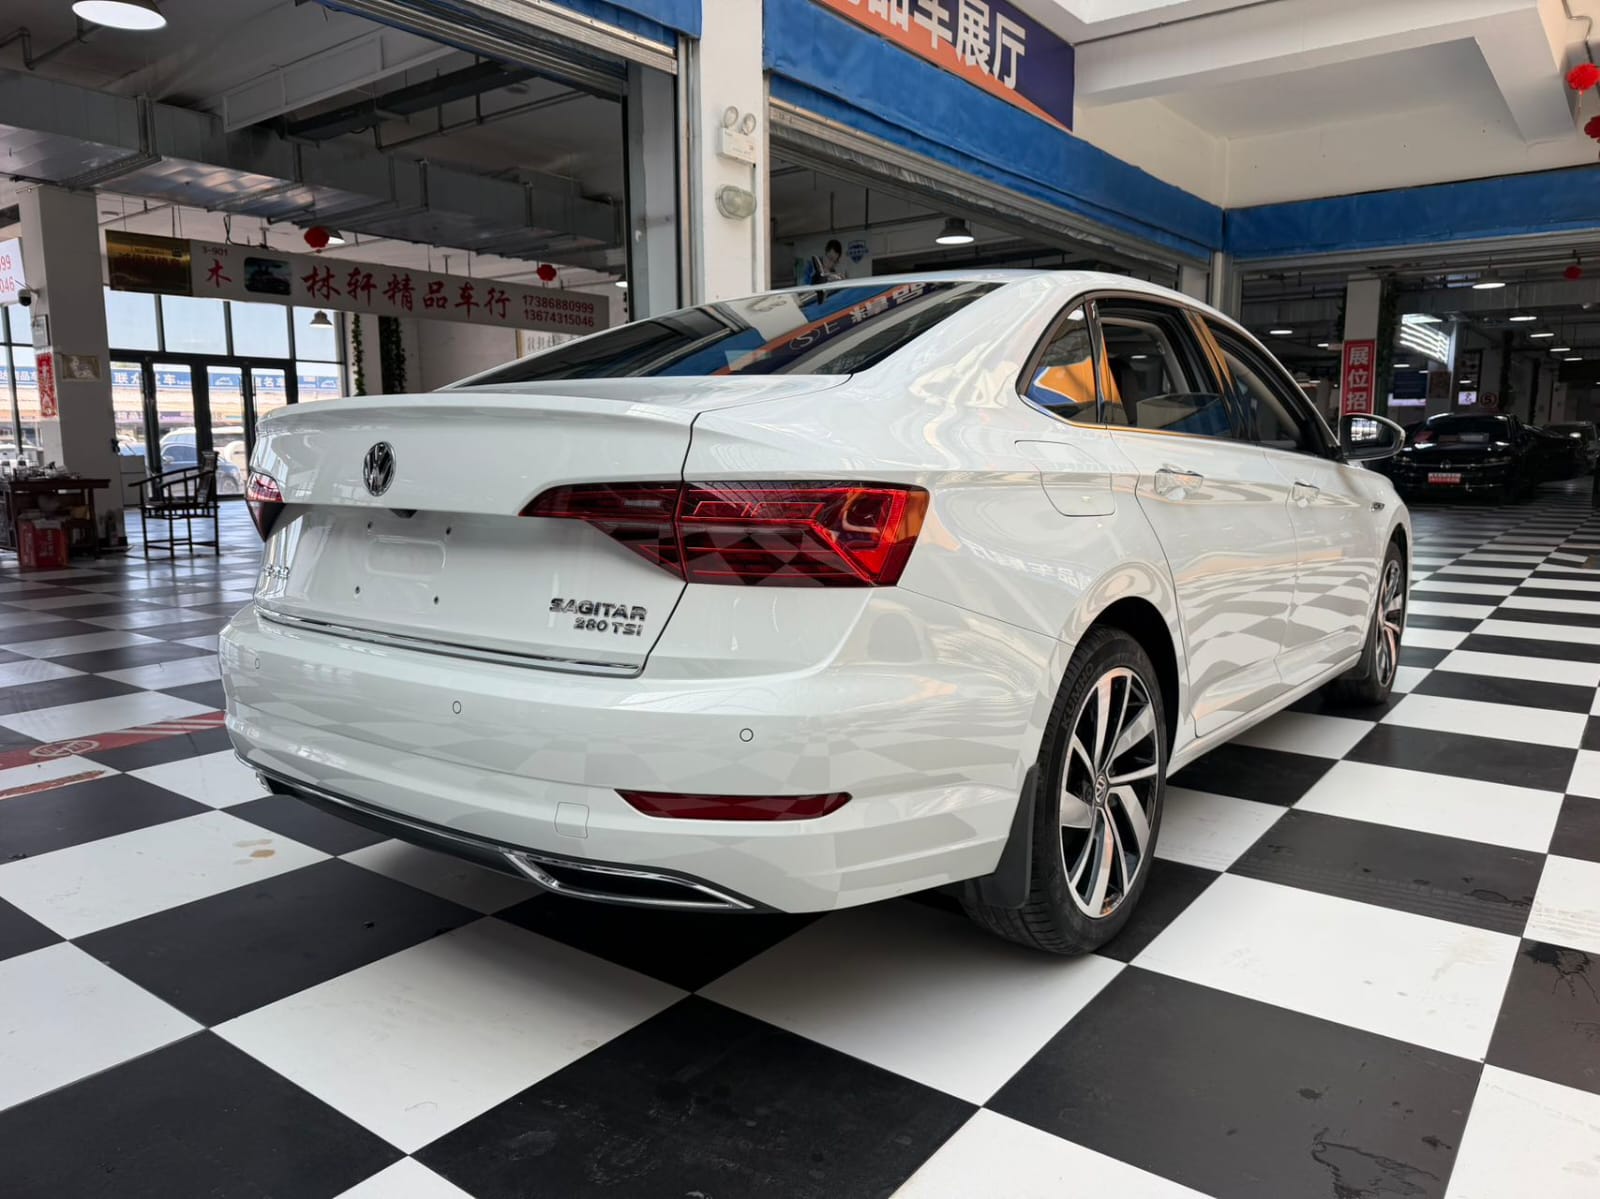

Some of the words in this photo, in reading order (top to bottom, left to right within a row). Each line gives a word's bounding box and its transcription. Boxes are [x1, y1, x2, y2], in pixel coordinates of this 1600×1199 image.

[848, 0, 1006, 90] 车展厅
[207, 258, 232, 288] 木
[301, 265, 511, 320] 林轩精品车行
[522, 294, 594, 314] 17386880999
[524, 309, 594, 327] 13674315046
[549, 598, 647, 621] SAGITAR
[575, 617, 608, 632] 280
